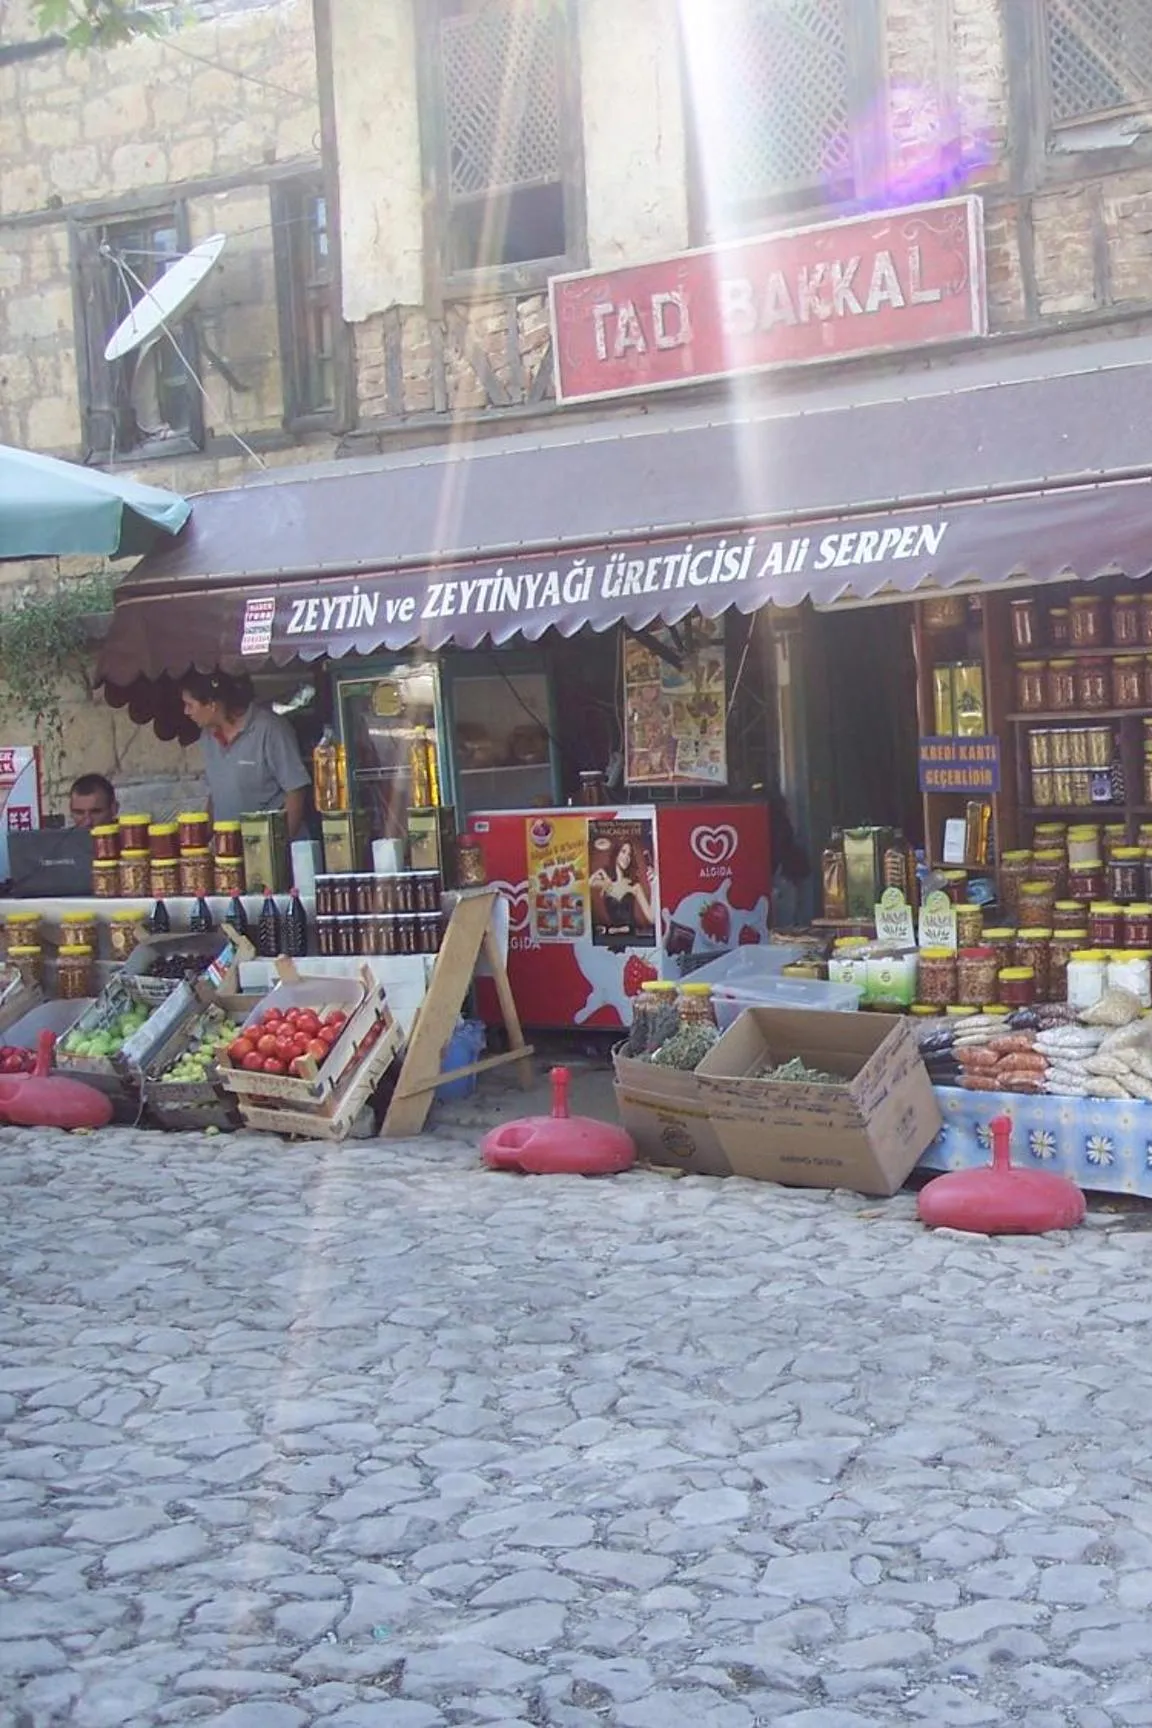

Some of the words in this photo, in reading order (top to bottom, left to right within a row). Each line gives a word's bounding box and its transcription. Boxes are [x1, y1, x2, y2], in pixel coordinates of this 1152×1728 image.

[287, 585, 379, 633] ZEYTİN
[385, 596, 414, 623] ve
[420, 559, 595, 619] ZEYTİNYAĞI
[601, 537, 755, 598] ÜRETİCİSİ
[814, 522, 949, 570] SERPEN
